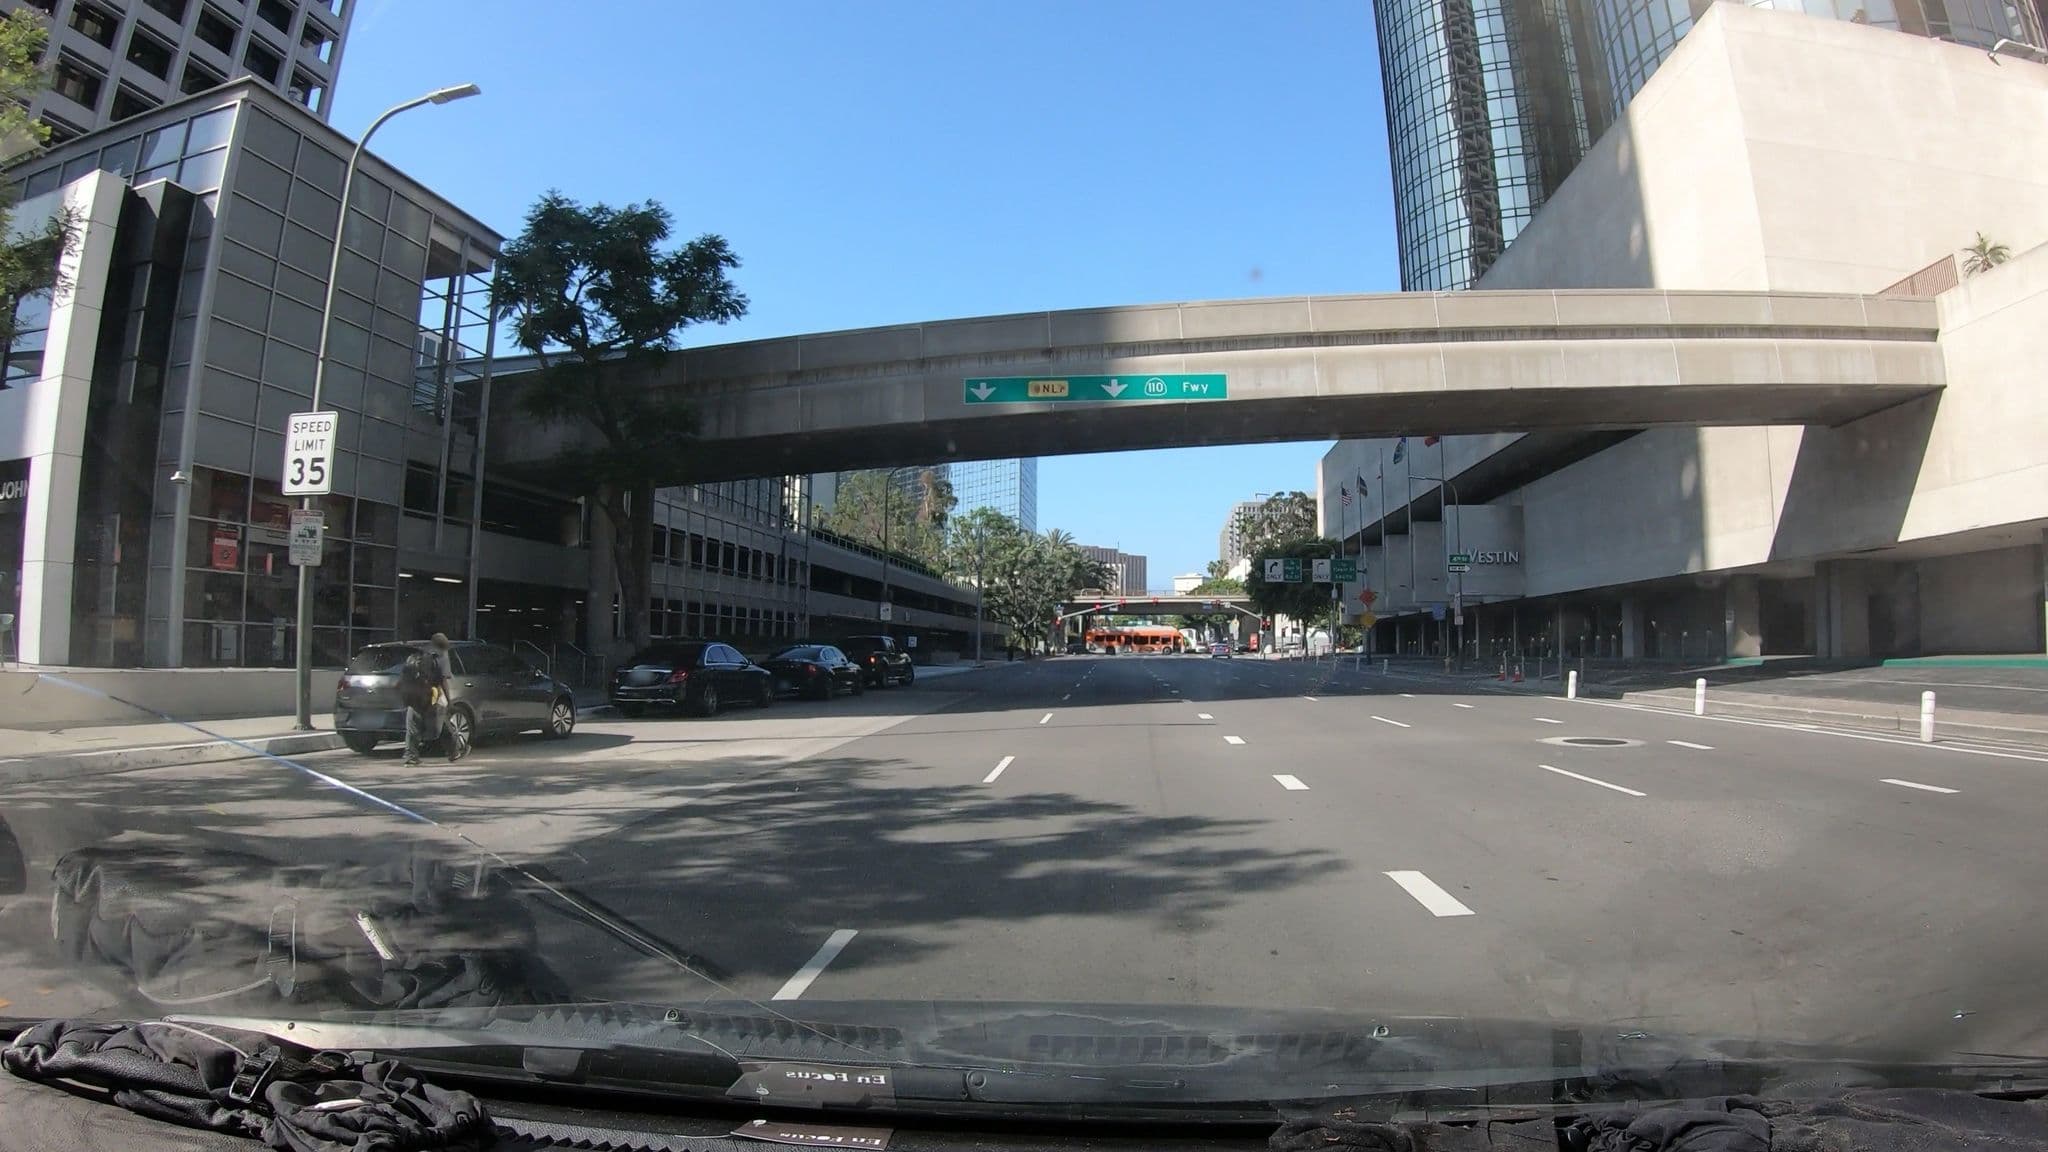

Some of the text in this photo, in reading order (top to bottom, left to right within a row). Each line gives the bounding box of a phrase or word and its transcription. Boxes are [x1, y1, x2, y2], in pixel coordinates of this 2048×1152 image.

[1148, 382, 1164, 393] 110
[1182, 382, 1208, 394] Fwy
[293, 421, 331, 434] SPEED
[294, 439, 326, 452] LIMIT
[290, 457, 325, 486] 35
